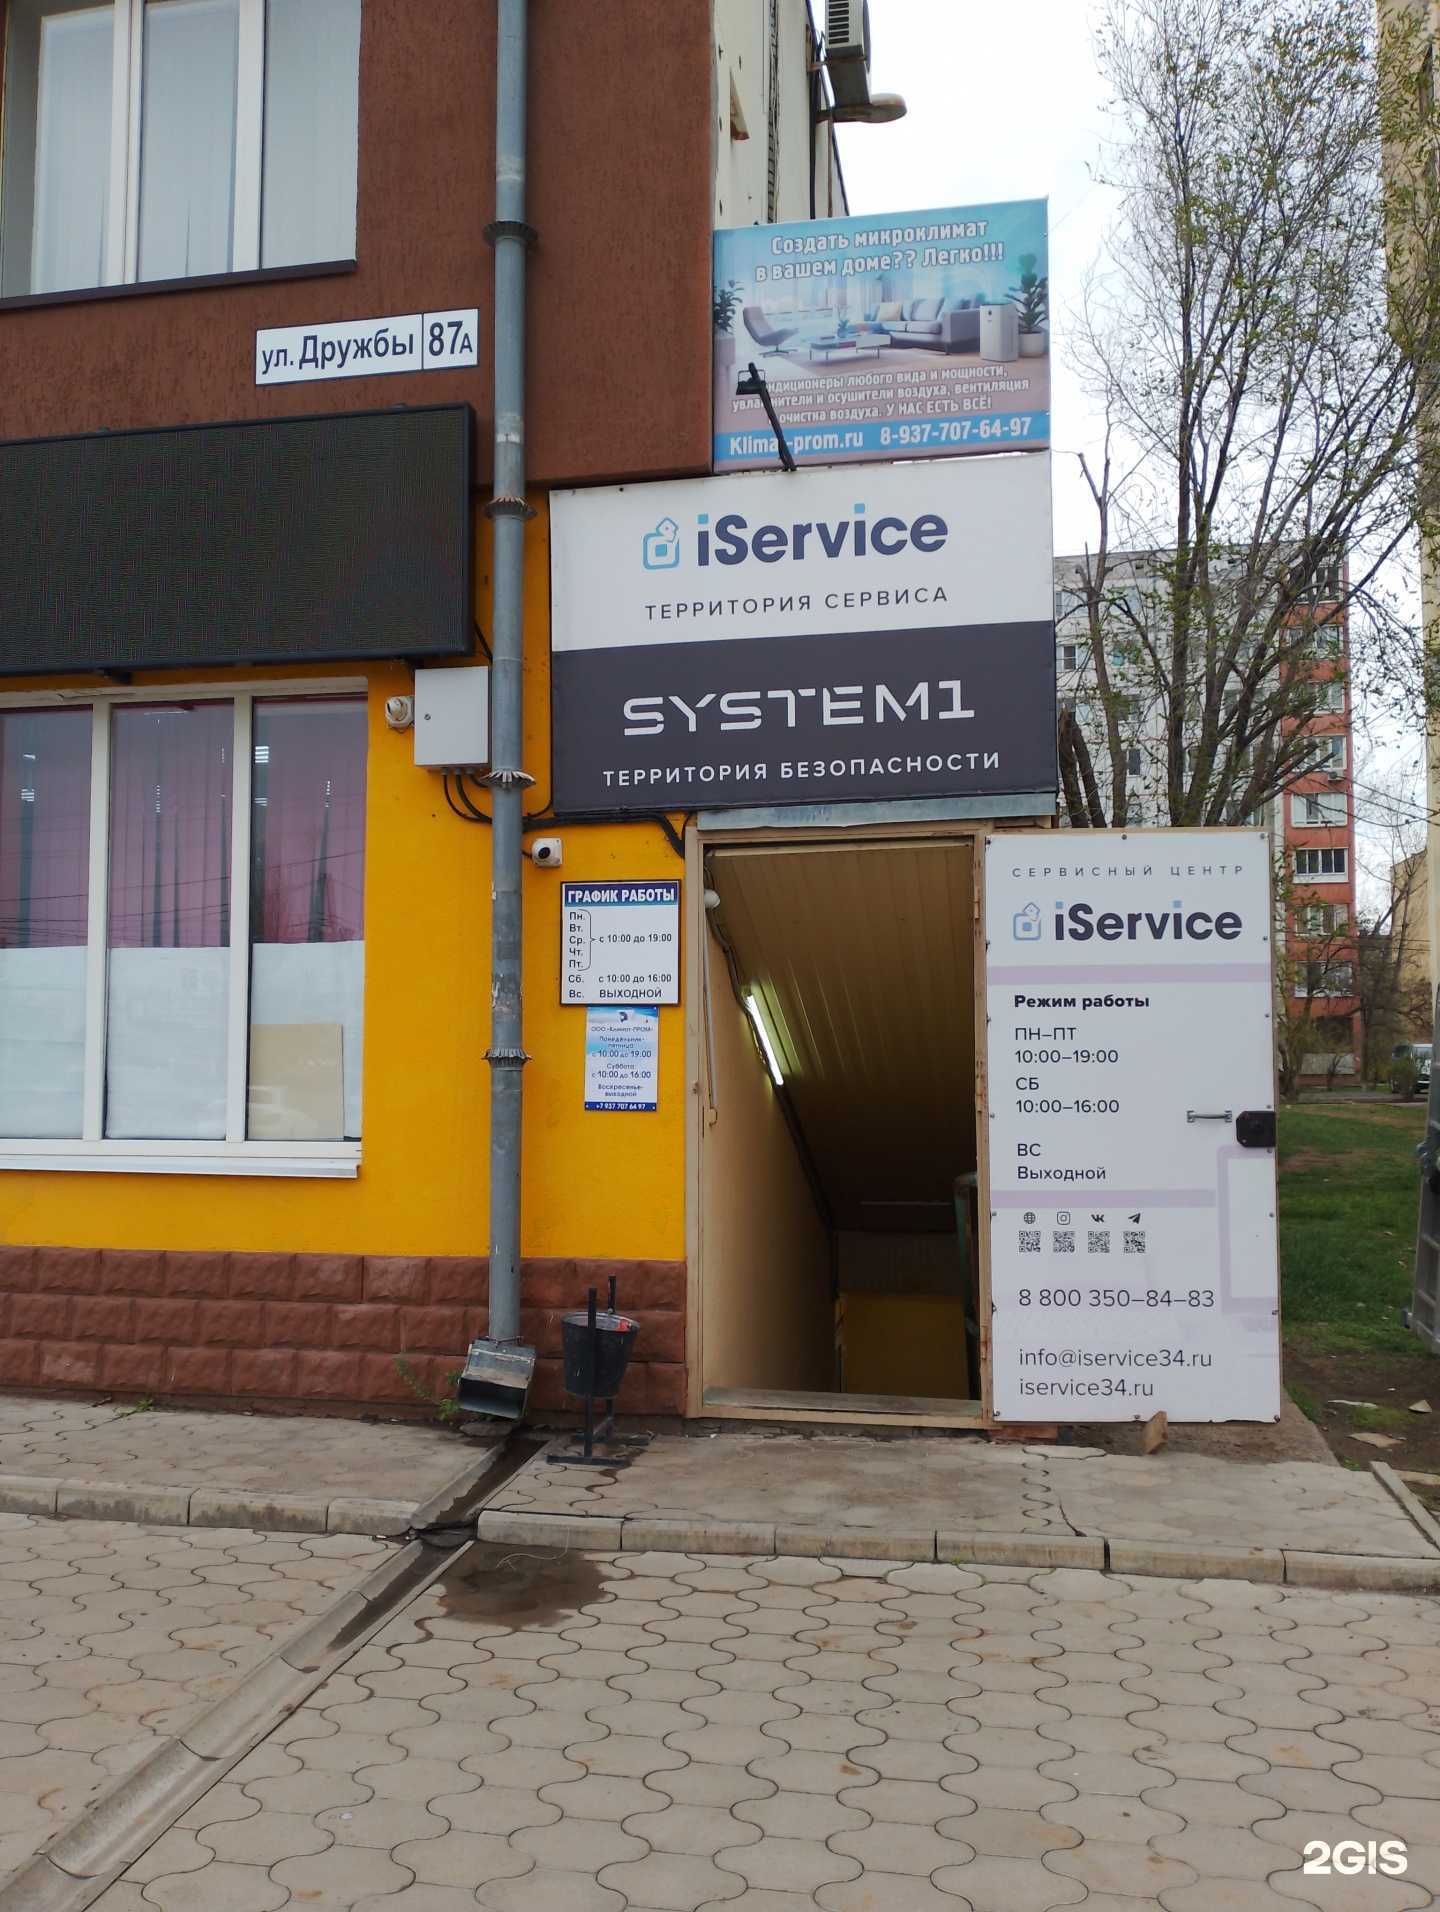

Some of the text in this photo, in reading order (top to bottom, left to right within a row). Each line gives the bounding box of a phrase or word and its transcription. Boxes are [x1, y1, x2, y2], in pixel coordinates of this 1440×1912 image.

[771, 220, 988, 254] Создать микроклимат
[755, 242, 1004, 281] в вашем доме?? Легко!!!
[262, 348, 294, 374] ул.
[299, 328, 414, 369] Дружбы
[761, 366, 1008, 393] ндиционеры любого вида и мощности,
[732, 379, 1029, 412] увланители и осушители воздуха, вентиляция
[780, 410, 826, 424] очистка
[830, 407, 881, 421] воздуха.
[886, 403, 895, 416] У
[899, 402, 923, 415] НАС
[927, 400, 959, 413] ЕСТЬ
[963, 396, 992, 410] ВСЁ!
[730, 416, 1032, 455] Klima-prom.ru 8-937-707-64-97
[697, 503, 949, 567] iService
[645, 586, 949, 621] ТЕРРИТОРИЯ СЕРВИСА
[623, 680, 976, 737] SYSTEM1
[603, 751, 1000, 788] ТЕРРИТОРИЯ БЕЗОПАСНОСТИ
[1012, 865, 1244, 878] СЕРВИСНЫЙ ЦЕНТР
[568, 888, 674, 902] ГРАФИК РАБОТЫ
[569, 912, 585, 920] Пн.
[1055, 900, 1243, 941] iService
[569, 924, 583, 932] Вт.
[569, 936, 585, 946] Ср.
[633, 935, 645, 944] до
[569, 948, 583, 956] Чт.
[569, 960, 583, 968] Пт.
[569, 974, 584, 983] Сб.
[633, 975, 644, 984] до
[648, 974, 671, 982] 16:00
[600, 988, 662, 998] ВЫХОДНОЙ
[1014, 994, 1150, 1010] Режим работы
[1015, 1050, 1118, 1064] 10:00–19:00
[1016, 1077, 1039, 1090] СБ
[1016, 1099, 1119, 1114] 10:00–16:00
[1017, 1144, 1041, 1157] ВС
[1018, 1166, 1106, 1182] Выходной
[1018, 1289, 1214, 1307] 8 800 350–84–83
[1019, 1348, 1212, 1368] info@iservice34.ru
[1020, 1378, 1154, 1397] iservice34.ru
